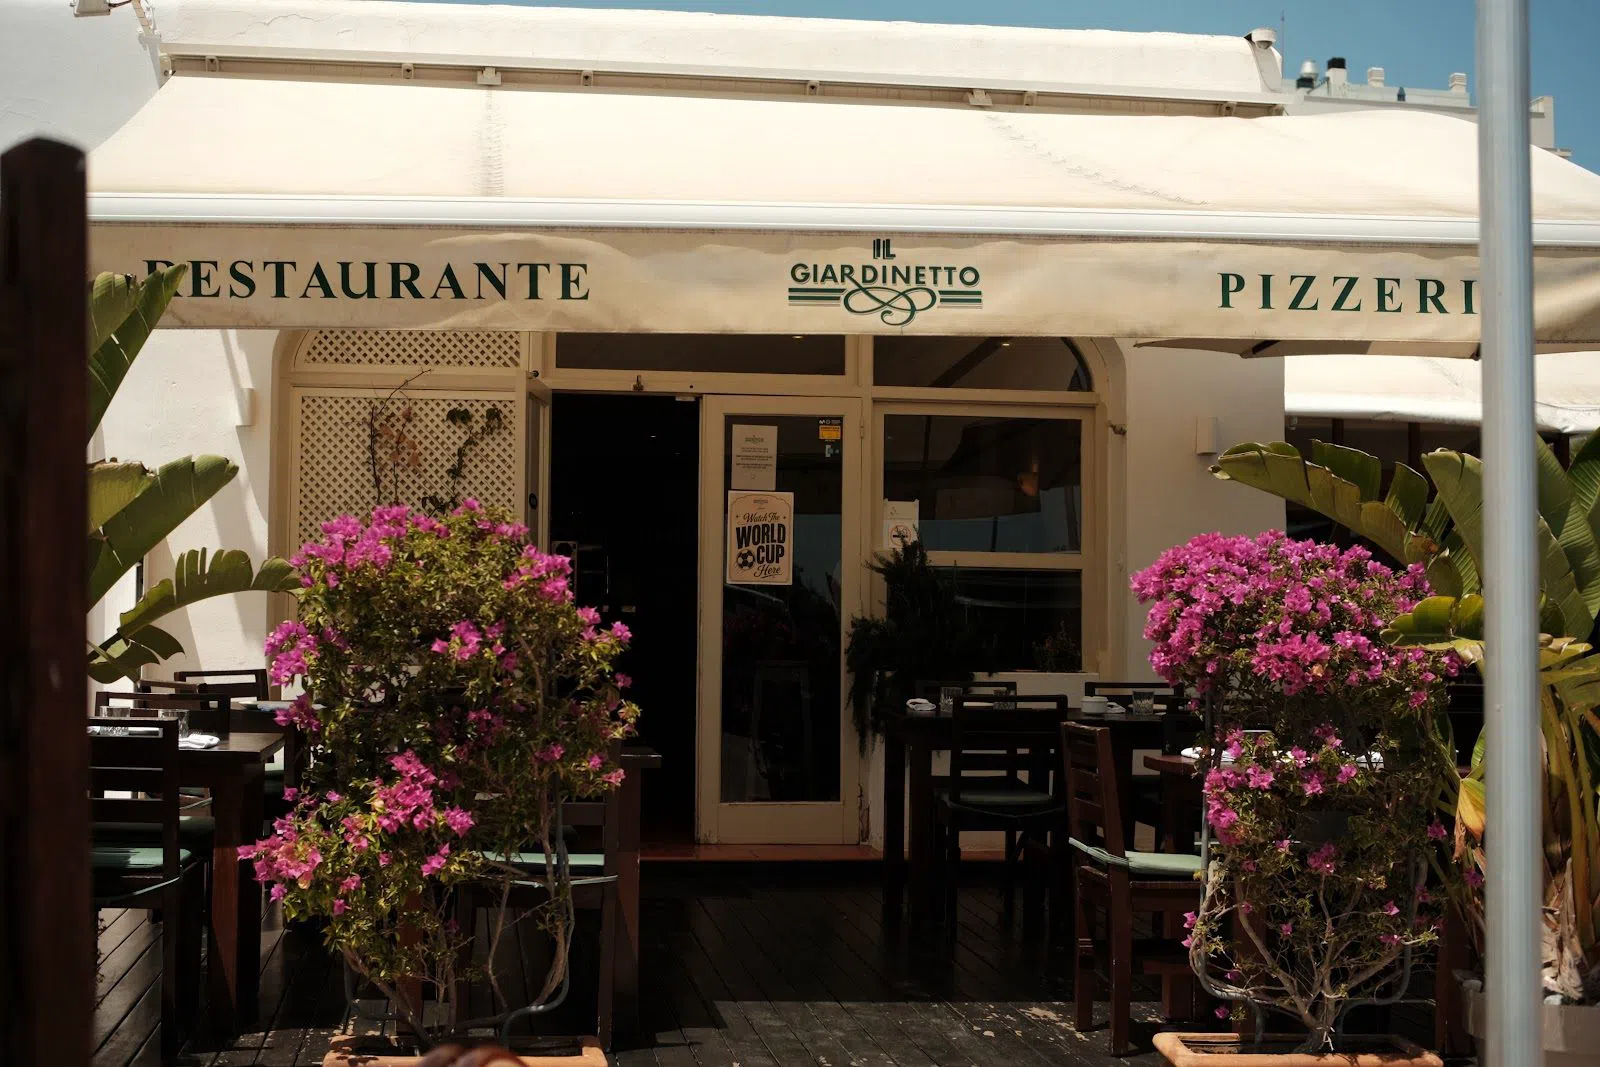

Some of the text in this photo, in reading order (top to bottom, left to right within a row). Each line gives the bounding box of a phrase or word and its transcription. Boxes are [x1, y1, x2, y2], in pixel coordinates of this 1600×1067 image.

[873, 238, 896, 259] IL
[790, 262, 980, 286] GIARDINETTO
[1218, 273, 1479, 314] PIZZERI
[743, 512, 781, 523] Watch The
[736, 523, 786, 549] WORLD
[756, 544, 785, 564] CUP
[753, 564, 783, 577] Here
